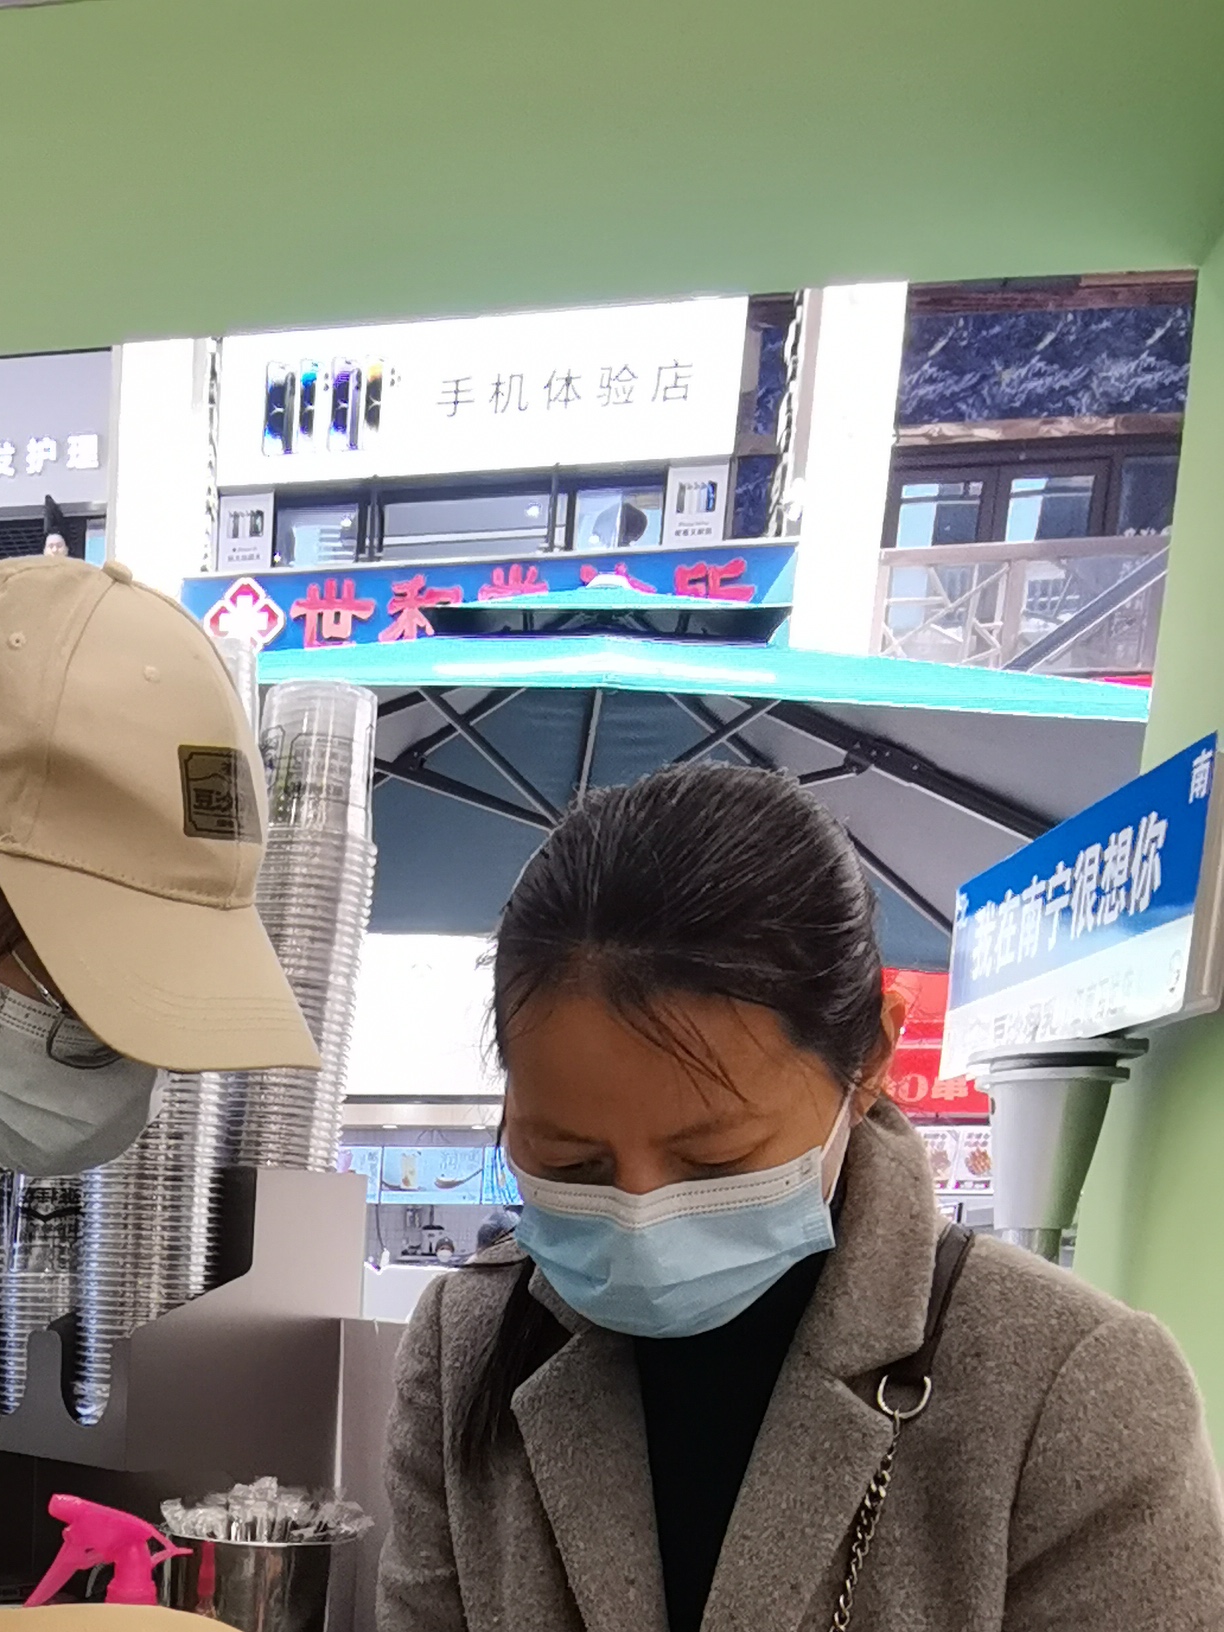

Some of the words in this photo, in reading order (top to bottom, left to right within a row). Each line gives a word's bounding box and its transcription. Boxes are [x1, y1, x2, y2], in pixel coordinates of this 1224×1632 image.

[437, 358, 693, 417] 手机体验店
[971, 810, 1169, 981] 我在南宁很想你
